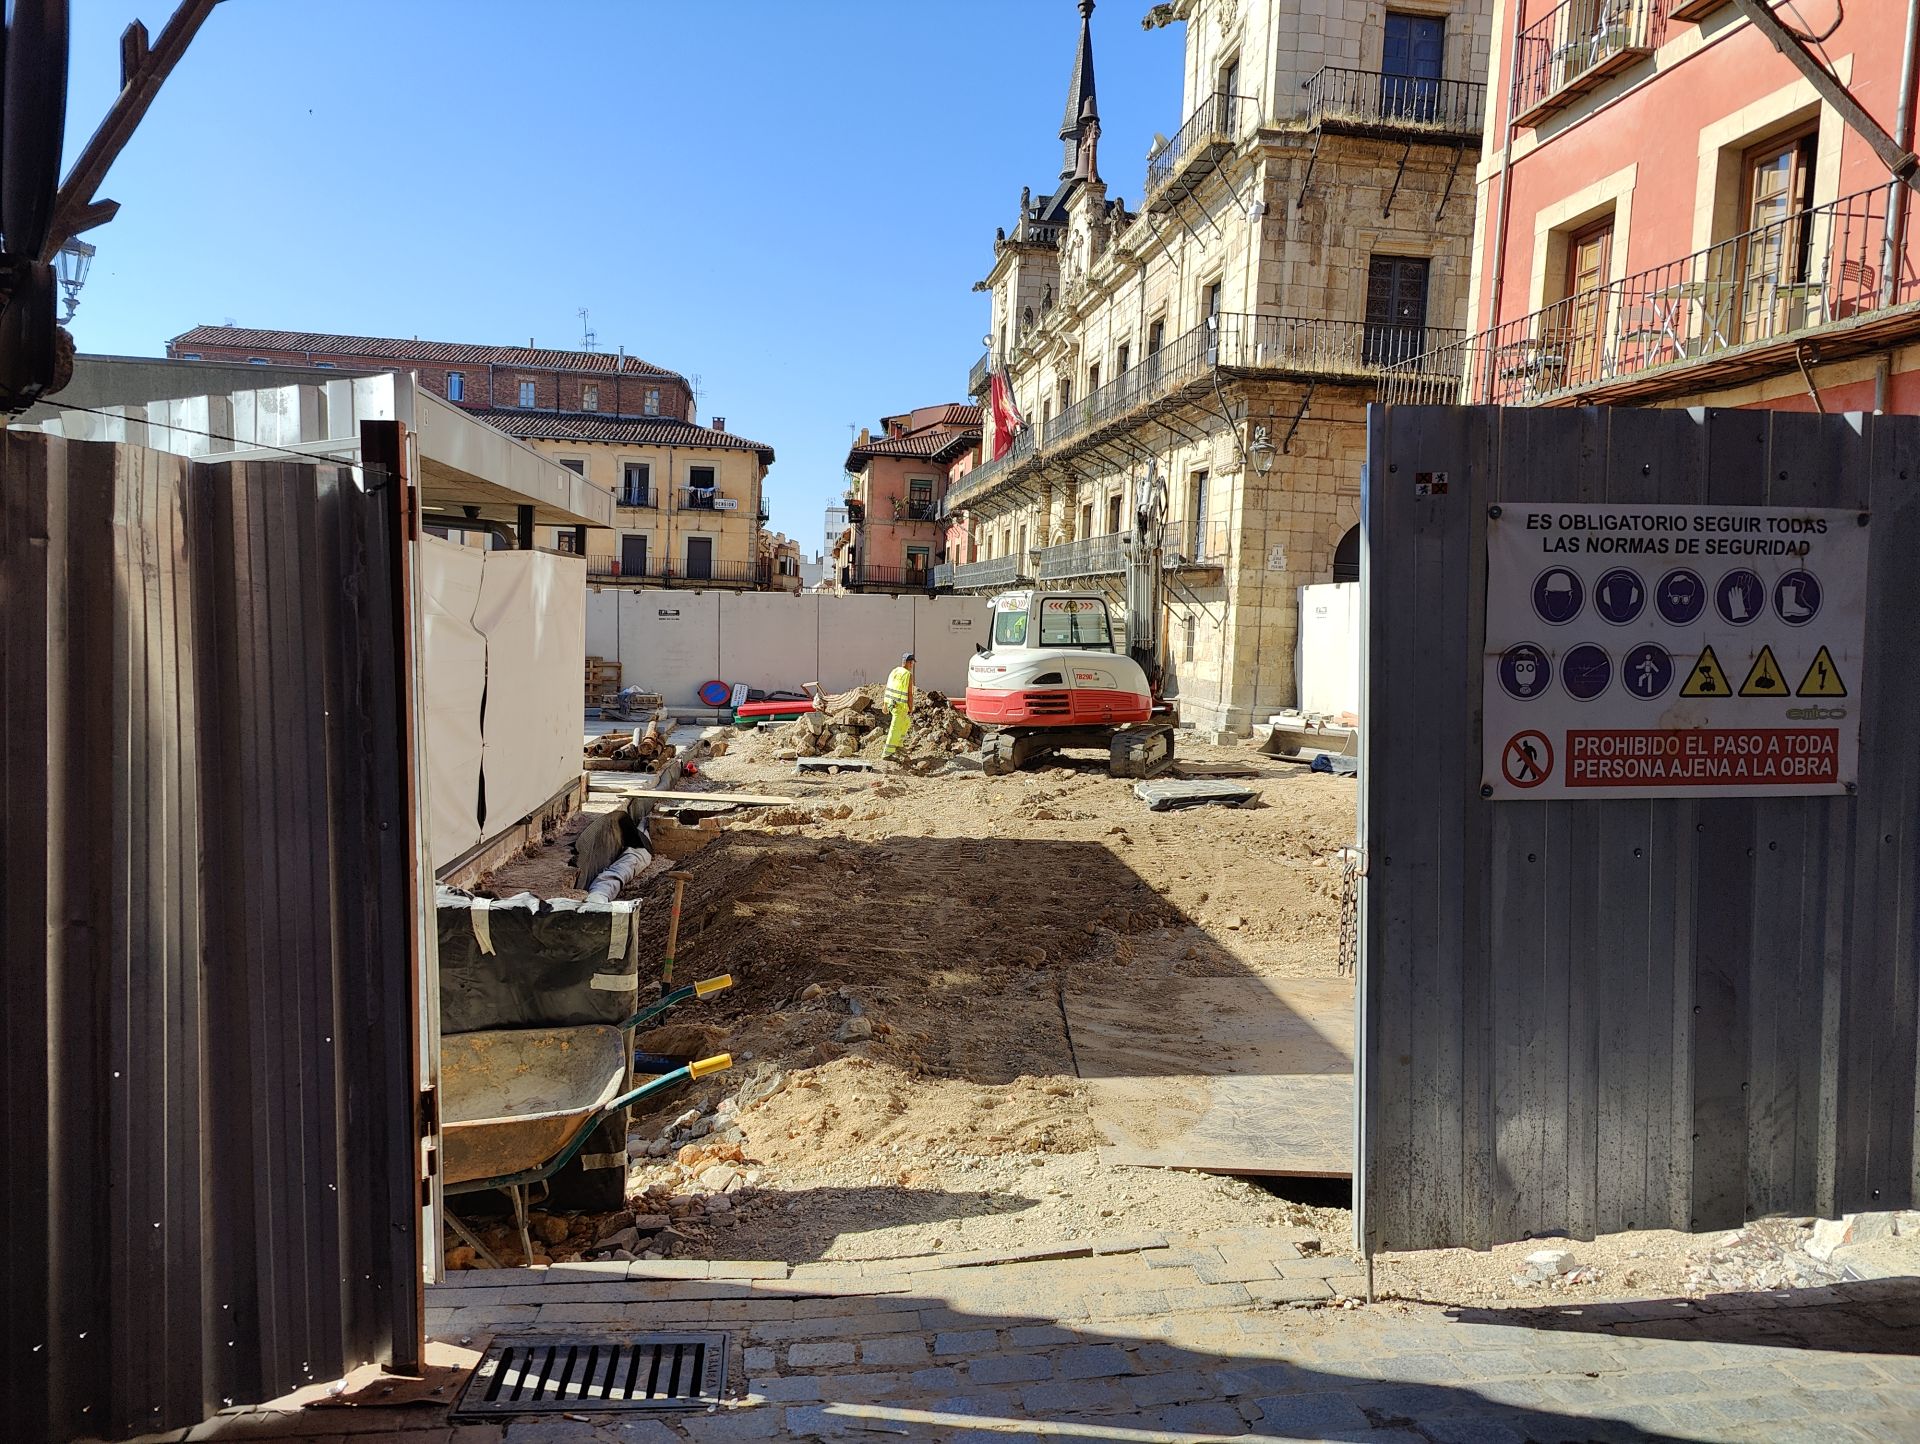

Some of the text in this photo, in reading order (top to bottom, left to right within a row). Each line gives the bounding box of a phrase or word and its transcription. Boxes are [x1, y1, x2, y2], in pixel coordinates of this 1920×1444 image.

[1526, 514, 1828, 534] ES OBLIGATORIO SEGUIR TODAS
[1543, 536, 1811, 556] LAS NORMAS DE SEGURIDAD
[1574, 735, 1834, 756] PROHIBIDO EL PASO A TODA
[1573, 757, 1832, 778] PERSONA AJENA A LA OBRA
